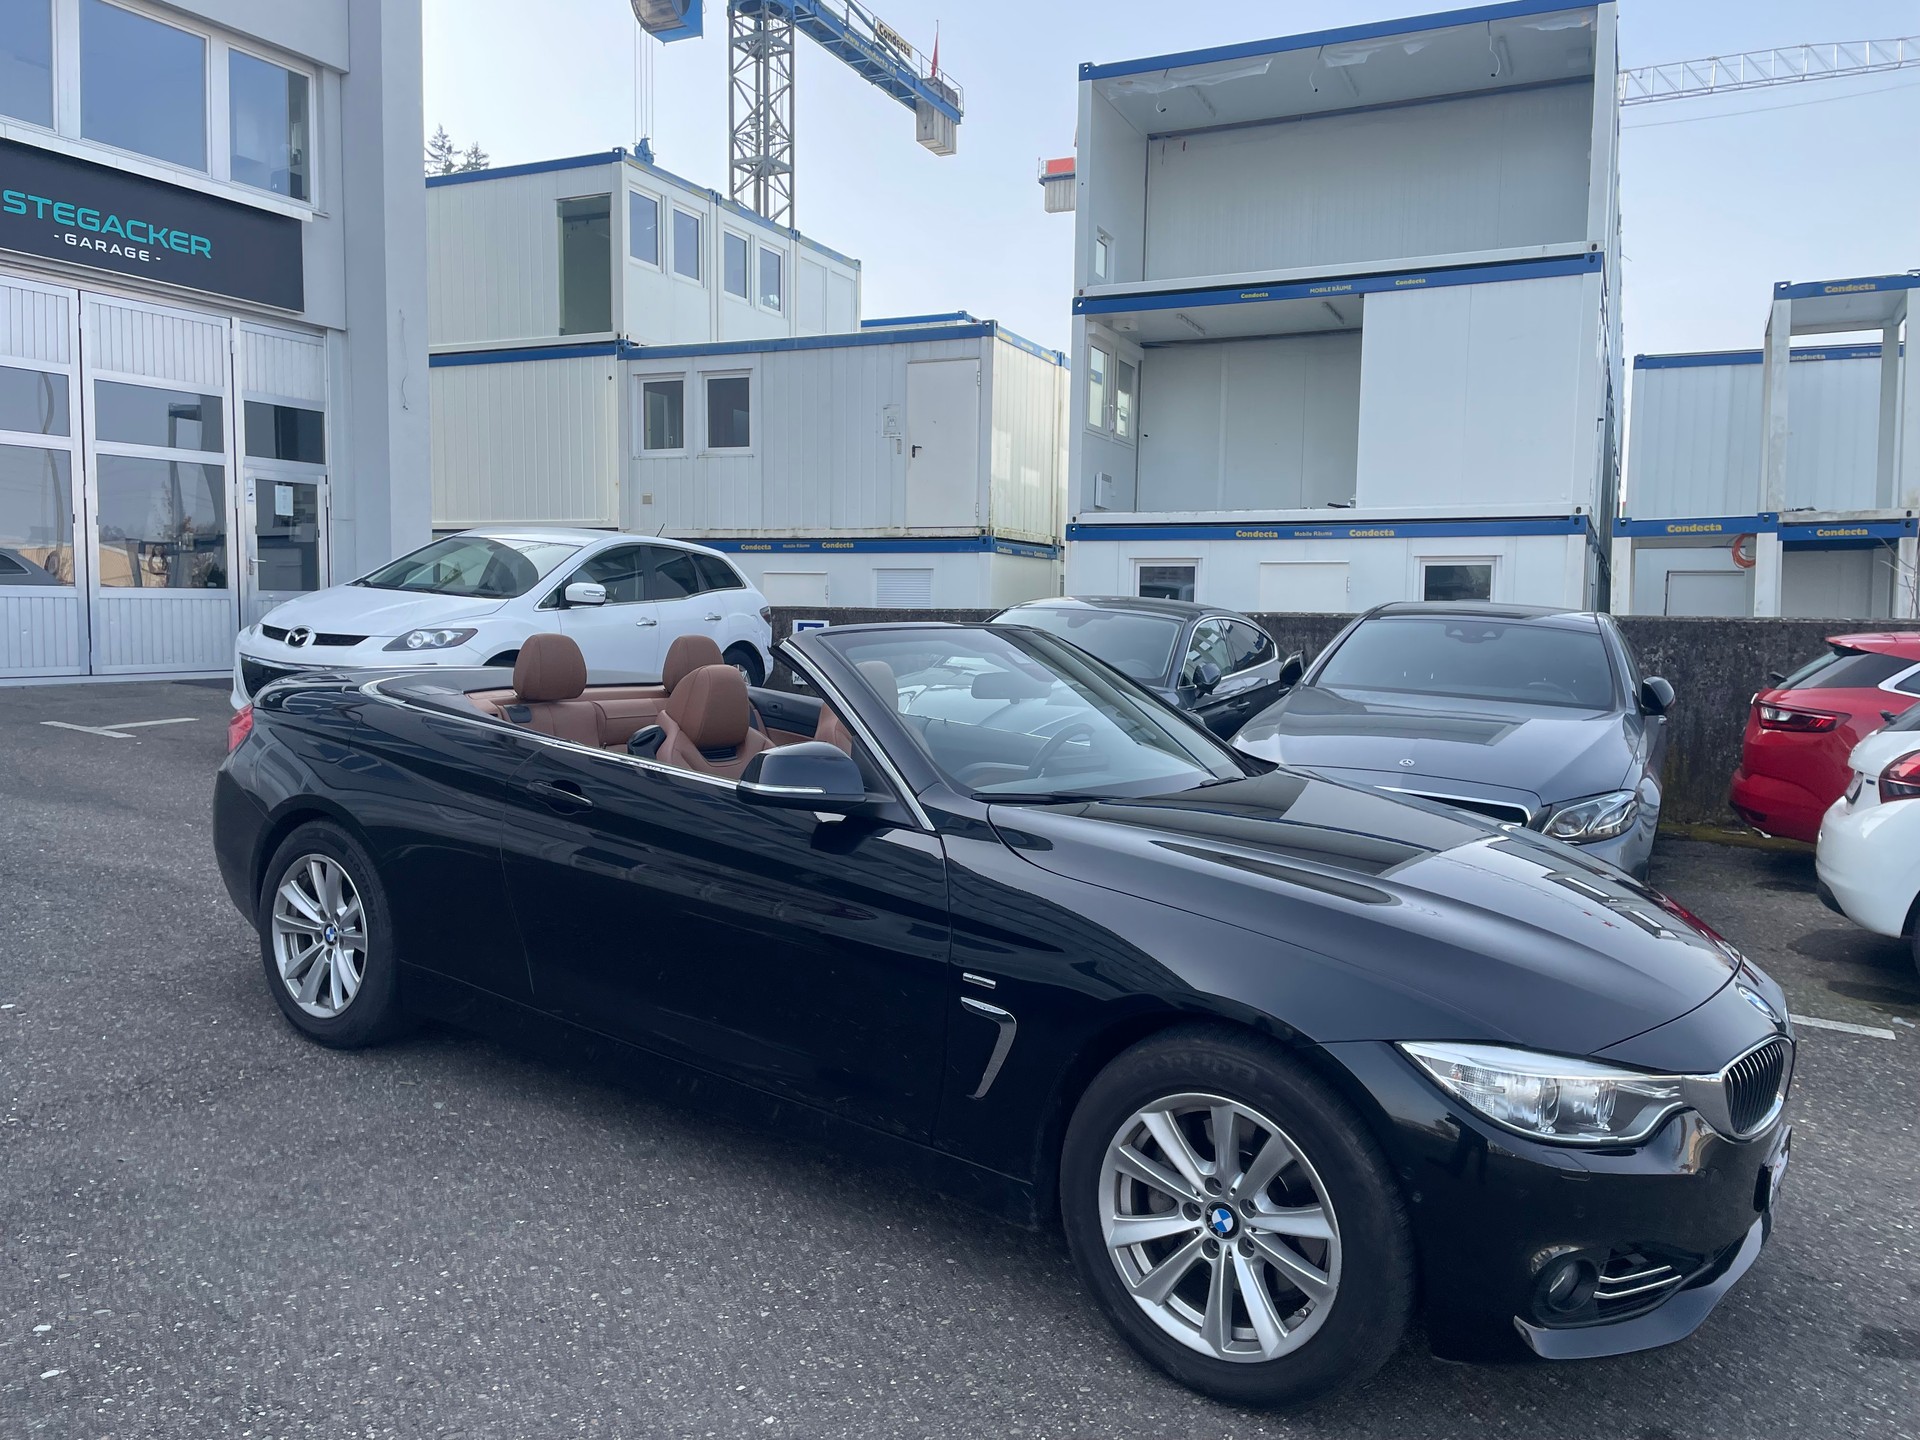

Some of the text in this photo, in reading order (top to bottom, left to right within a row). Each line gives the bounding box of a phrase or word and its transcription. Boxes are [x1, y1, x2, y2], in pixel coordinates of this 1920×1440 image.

[878, 23, 911, 58] Condecta
[3, 189, 212, 259] STEGACKER
[1240, 291, 1269, 299] Condecta
[1395, 278, 1426, 286] Condecta
[1824, 282, 1876, 294] Condecta
[1790, 353, 1826, 361] ondecta
[1235, 529, 1279, 539] Condecta
[1349, 528, 1395, 538] Condecta
[1667, 522, 1722, 534] Condecta
[1816, 527, 1868, 537] Condecta
[740, 543, 772, 551] Condecta
[821, 541, 854, 549] Condecta
